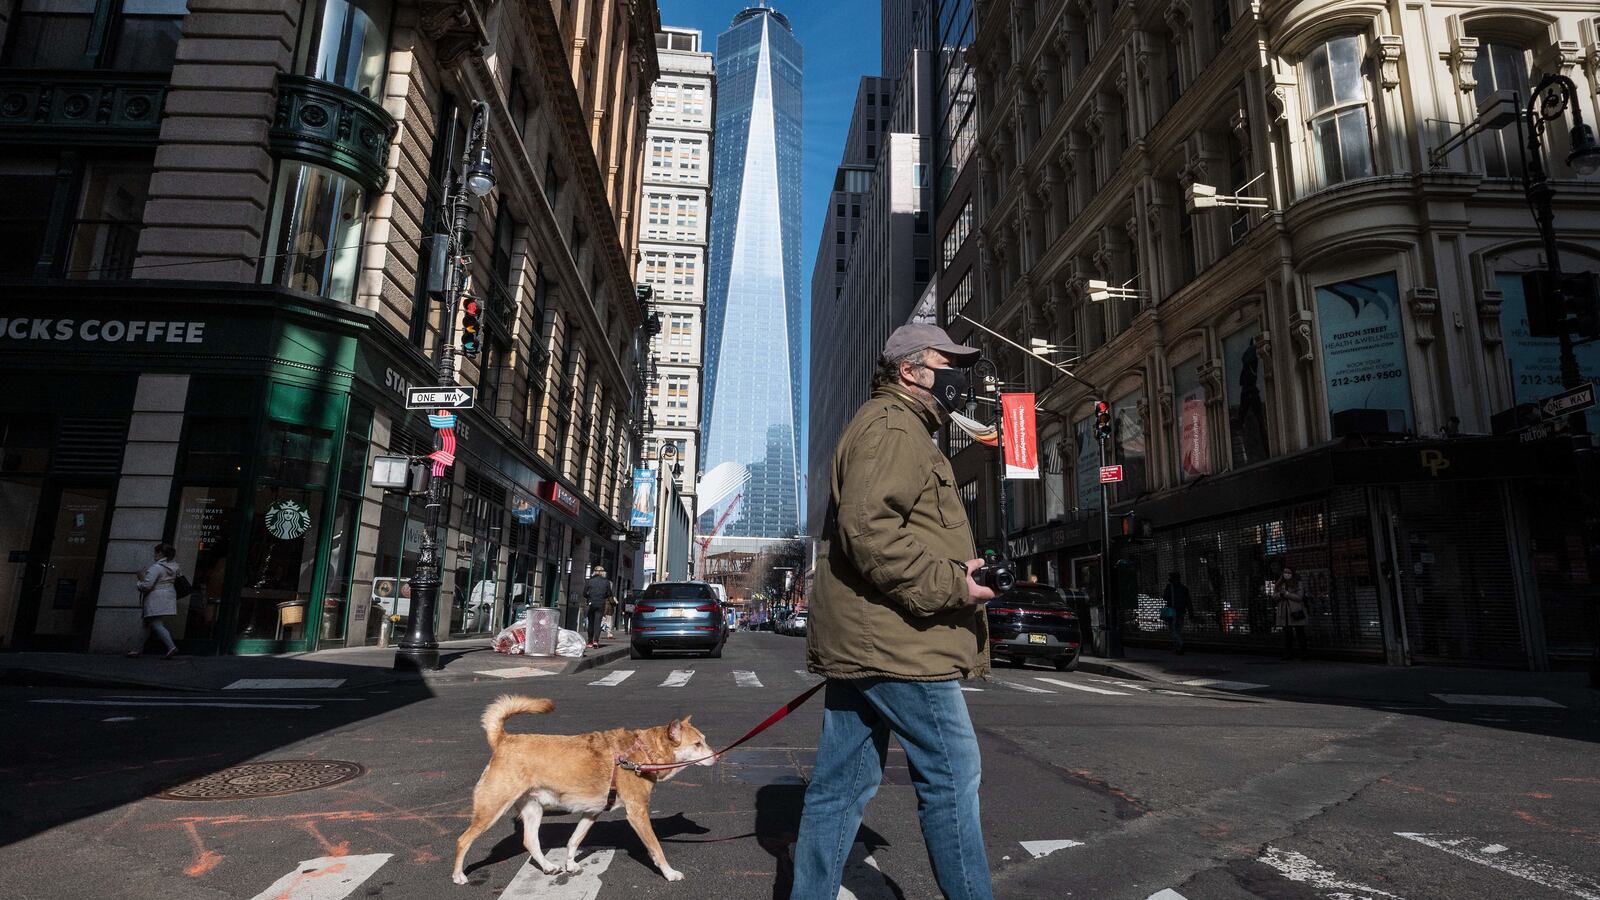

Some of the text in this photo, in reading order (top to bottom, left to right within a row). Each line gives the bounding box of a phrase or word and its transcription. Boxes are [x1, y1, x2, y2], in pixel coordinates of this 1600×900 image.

[79, 319, 207, 343] COFFEE
[1333, 325, 1388, 340] FULTON STREET
[1331, 369, 1402, 386] 212-349-9500
[417, 393, 464, 402] ONE WAY
[1547, 391, 1587, 412] ONE WAY
[1519, 430, 1547, 443] FULTON
